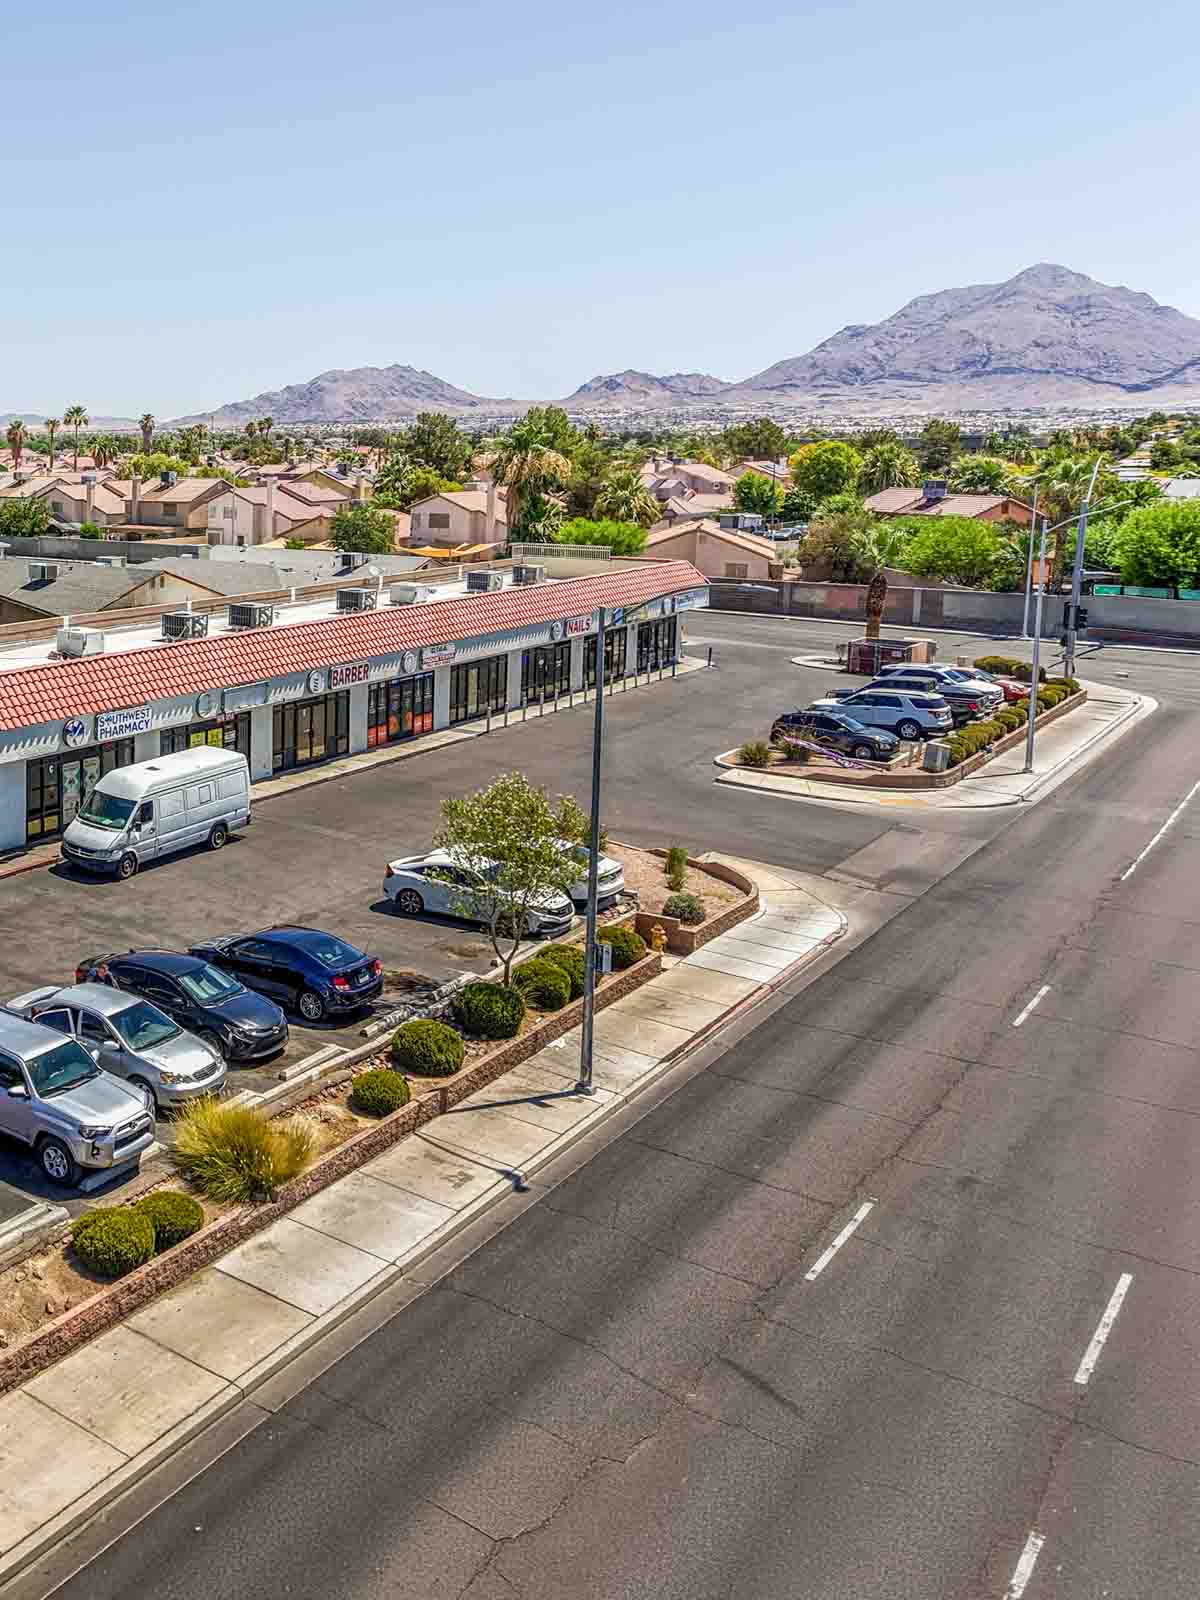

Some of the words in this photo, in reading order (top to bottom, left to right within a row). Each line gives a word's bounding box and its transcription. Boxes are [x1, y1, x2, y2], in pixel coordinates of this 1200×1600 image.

[567, 617, 592, 634] NAILS
[332, 663, 369, 687] BARBER
[99, 718, 151, 738] PHARMACY
